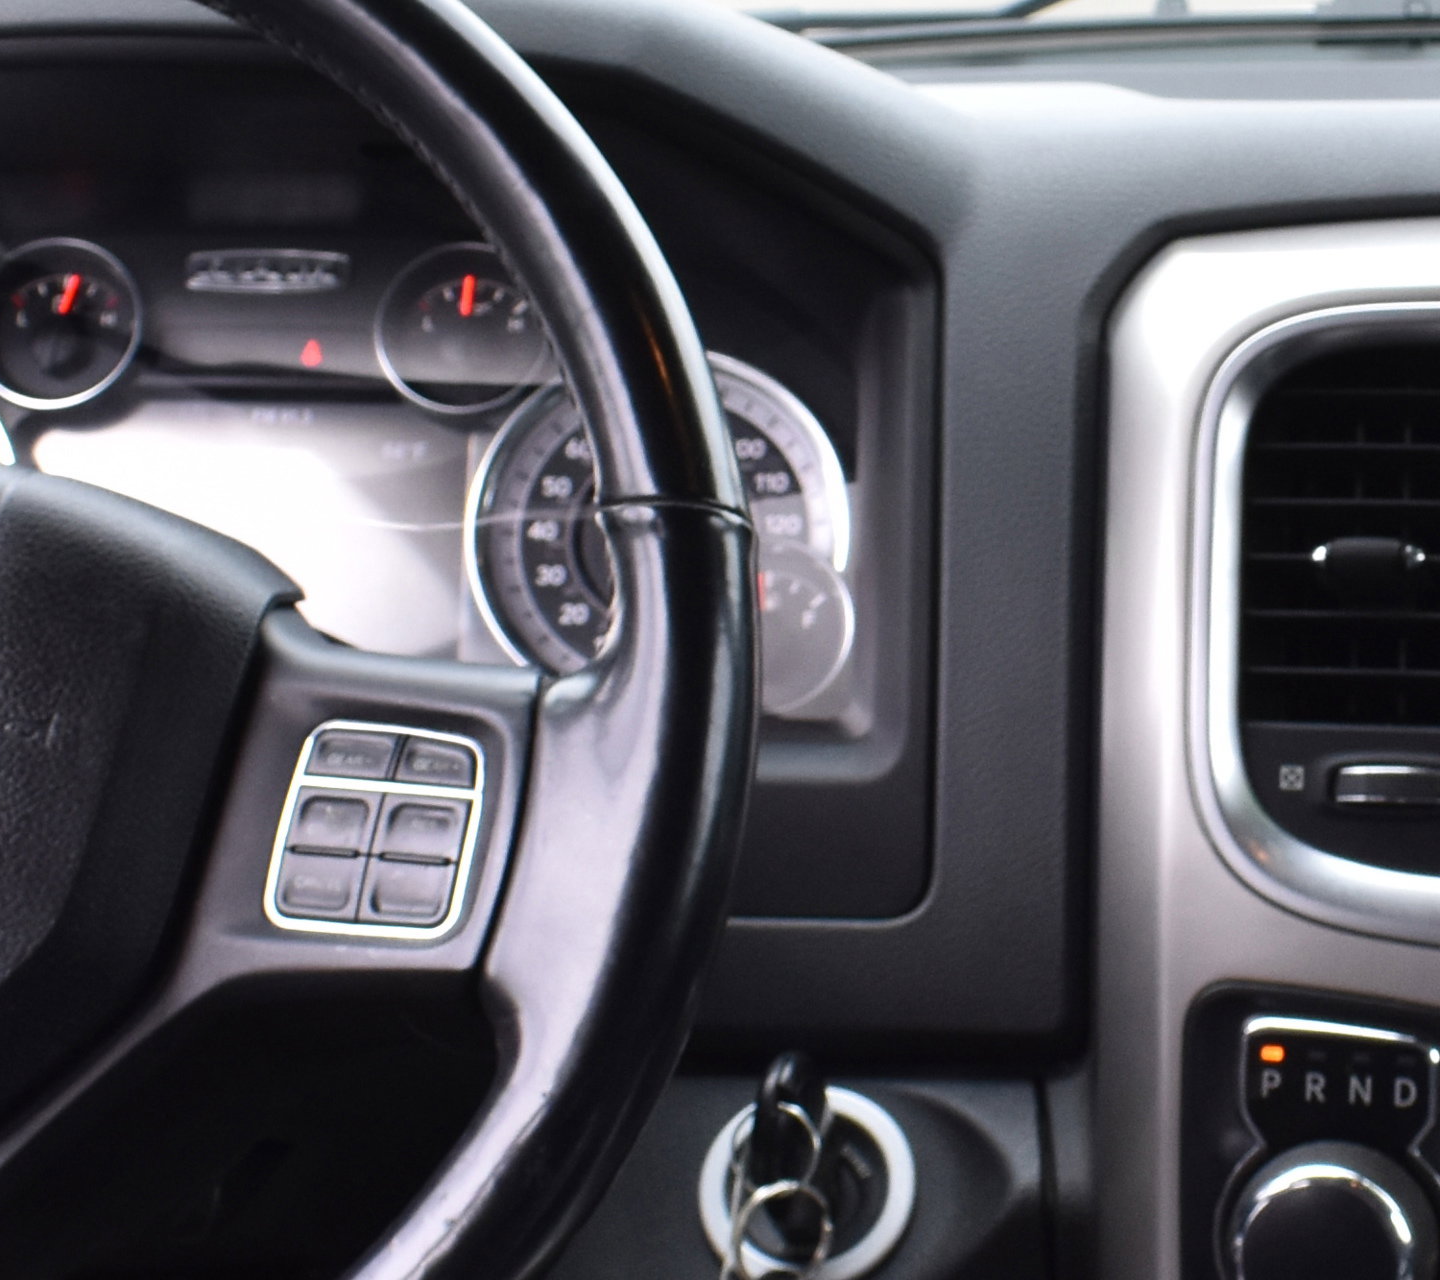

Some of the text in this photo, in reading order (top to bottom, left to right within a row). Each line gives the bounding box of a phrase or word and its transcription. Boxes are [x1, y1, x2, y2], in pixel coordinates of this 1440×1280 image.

[735, 438, 766, 461] 00
[541, 475, 572, 498] 50
[754, 472, 789, 494] 110
[527, 519, 558, 542] 40
[765, 513, 803, 536] 120
[535, 563, 566, 587] 30
[558, 601, 589, 626] 20
[1262, 1070, 1418, 1108] P R N D
